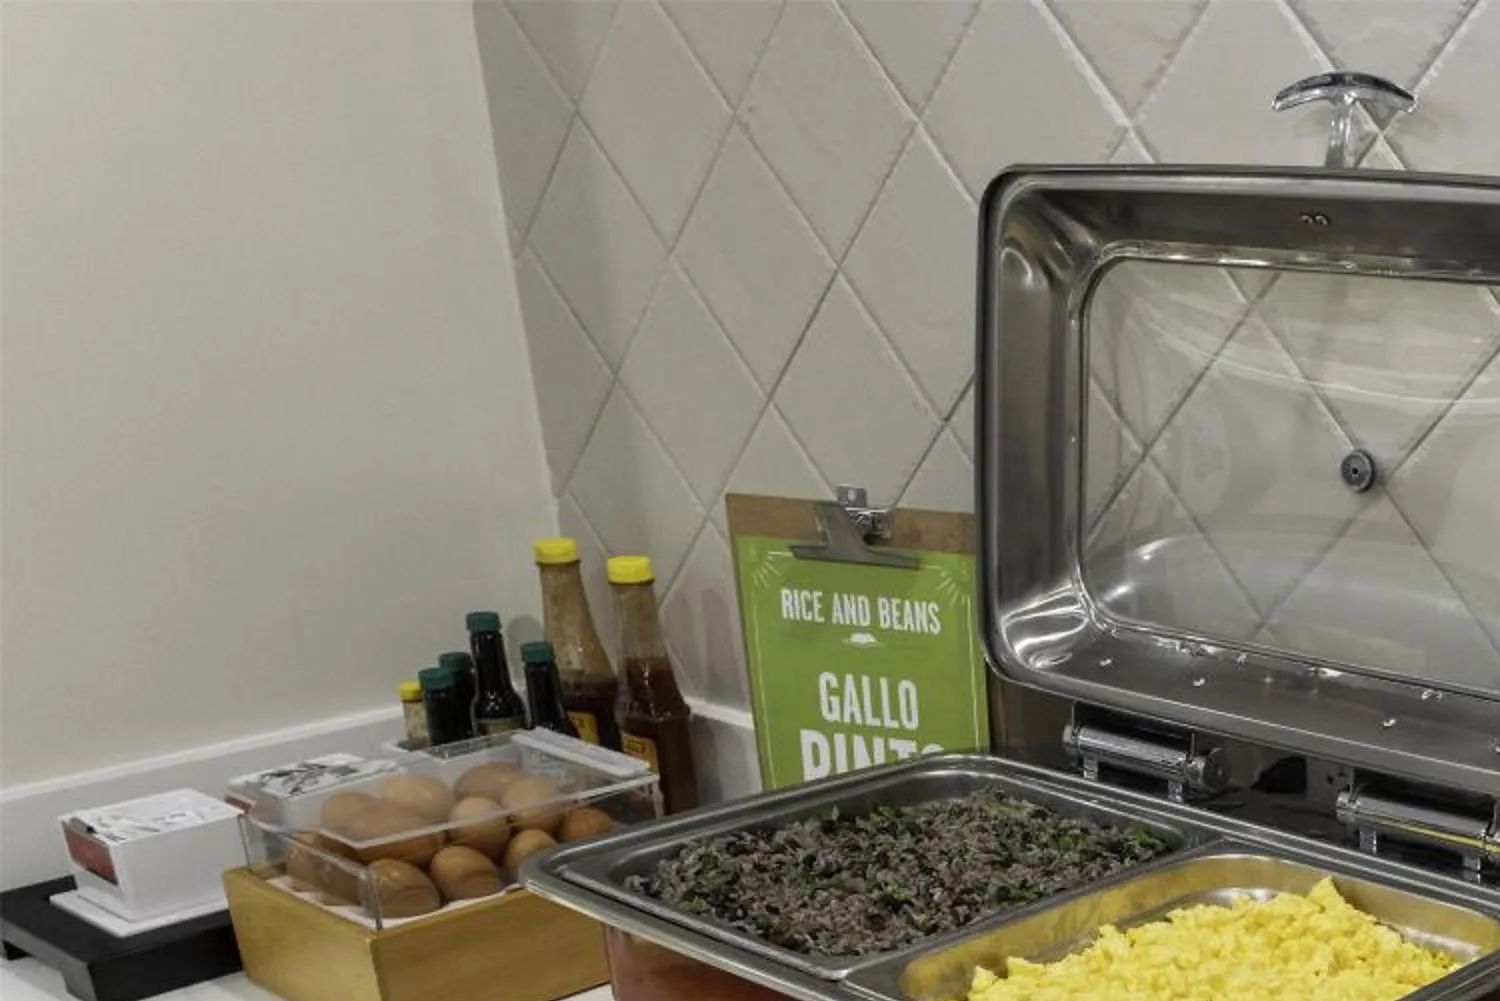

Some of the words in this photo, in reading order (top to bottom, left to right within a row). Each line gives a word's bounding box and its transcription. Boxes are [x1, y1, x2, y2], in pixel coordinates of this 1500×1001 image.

[780, 588, 825, 623] RICE
[831, 592, 871, 627] AND
[878, 596, 941, 635] BEANS
[818, 671, 919, 730] GALLO
[800, 728, 945, 781] PIN
